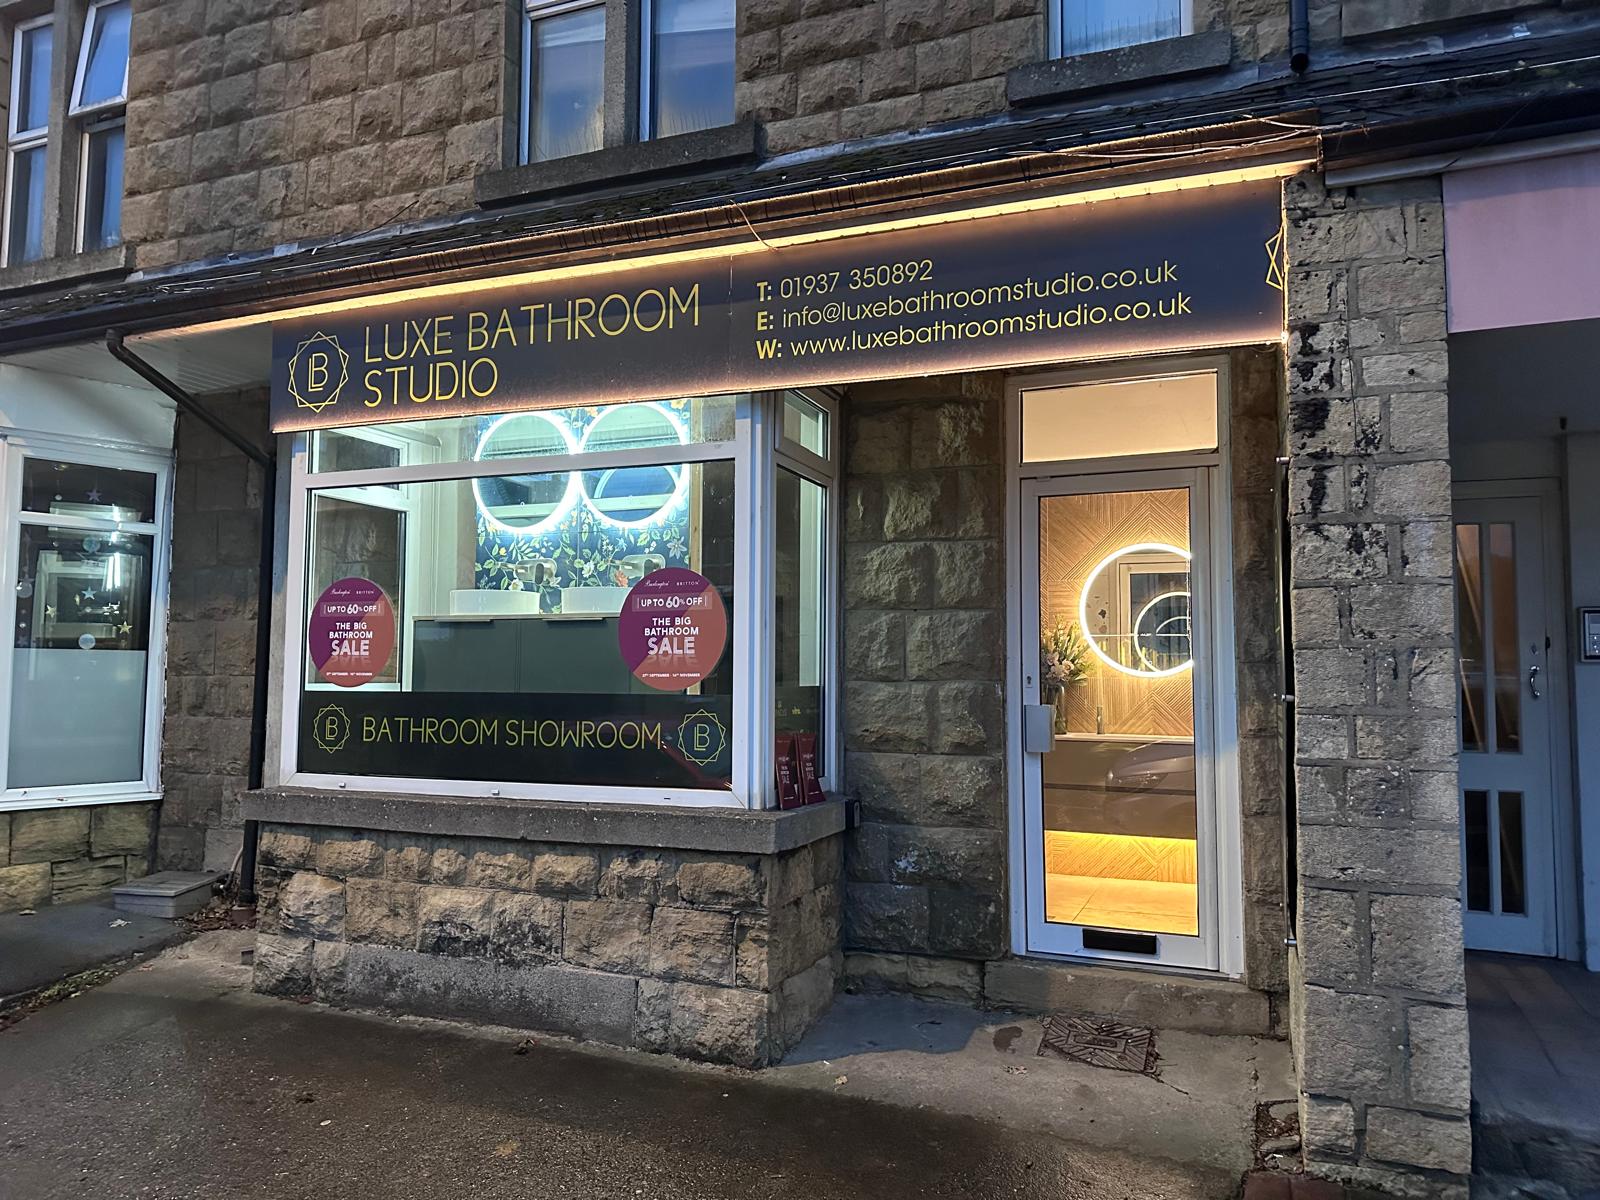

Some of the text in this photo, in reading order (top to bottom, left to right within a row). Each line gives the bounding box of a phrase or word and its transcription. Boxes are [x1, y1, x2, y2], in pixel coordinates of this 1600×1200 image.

[757, 259, 933, 301] T: 01937 350892
[757, 260, 1178, 331] E: info@luxebathroomstudio.co.uk
[365, 283, 700, 364] LUXE BATHROOM
[756, 291, 1192, 359] W: www.luxebathroomstudio.co.uk
[364, 357, 498, 408] STUDIO
[687, 597, 703, 605] OFF
[336, 622, 367, 630] THE BIG
[652, 616, 692, 626] THE BIG
[329, 631, 373, 639] BATHROOM
[644, 626, 699, 636] BATHROOM
[331, 639, 370, 656] SALE
[647, 637, 695, 655] SALE
[363, 716, 662, 750] BATHROOM SHOWROOM
